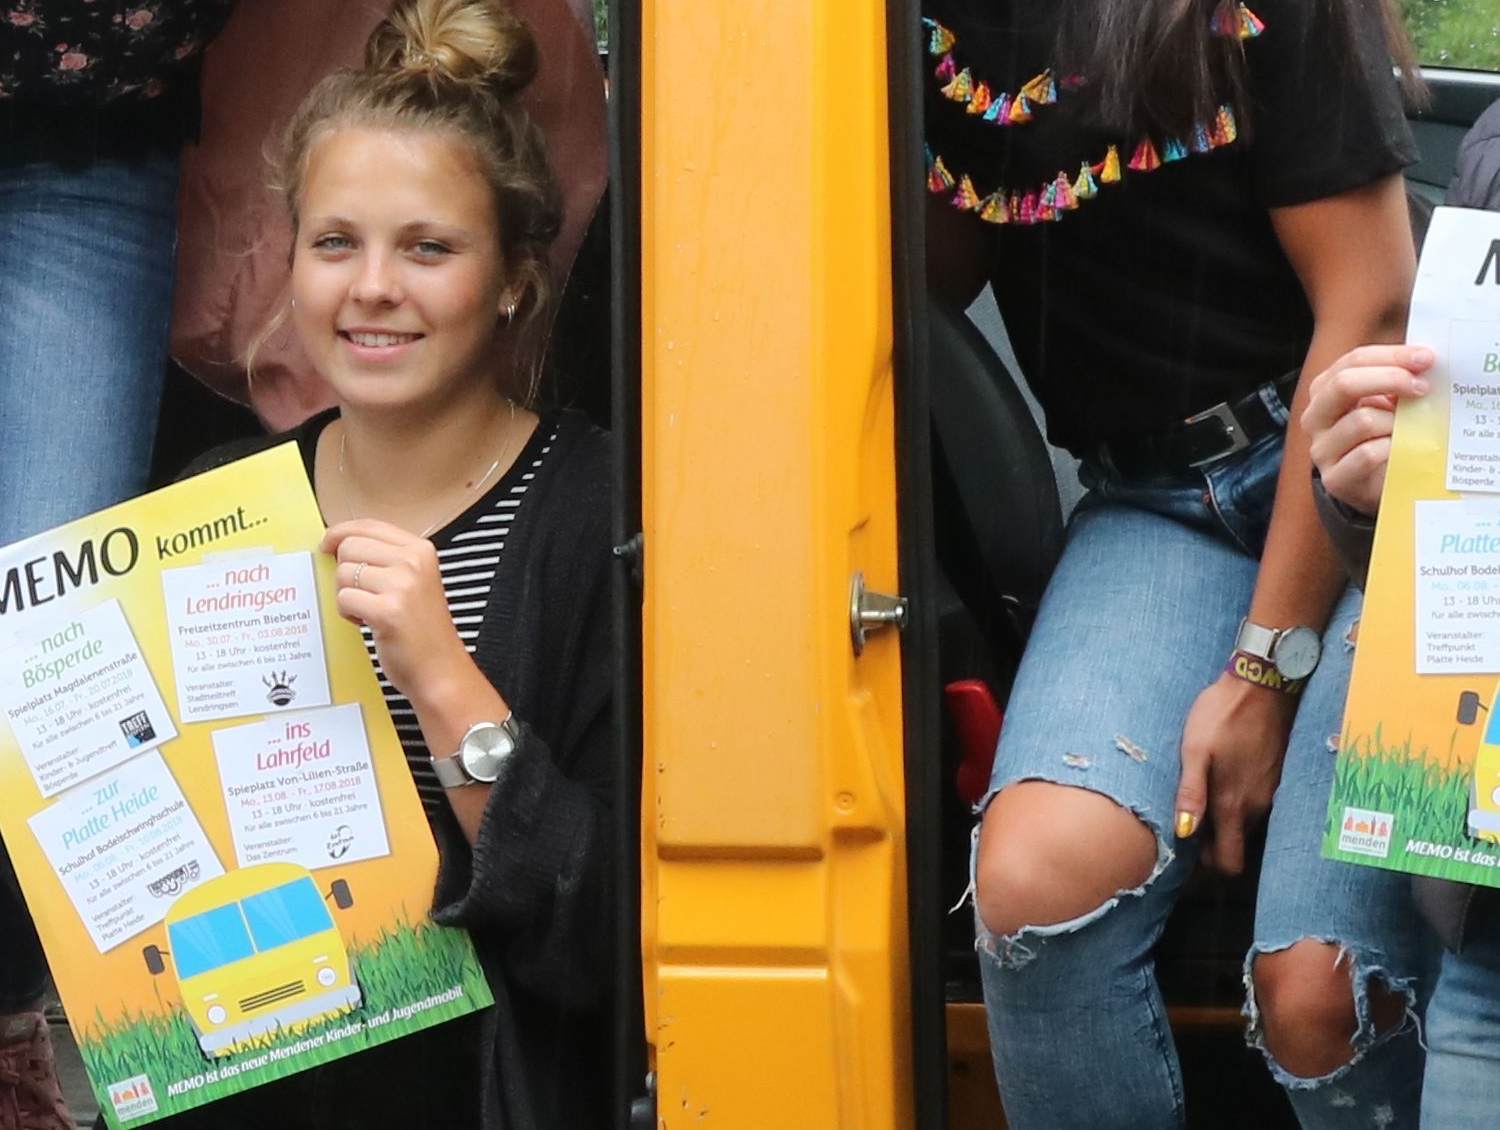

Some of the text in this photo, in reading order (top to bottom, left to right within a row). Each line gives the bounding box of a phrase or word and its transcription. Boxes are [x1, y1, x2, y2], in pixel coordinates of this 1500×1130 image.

[1474, 414, 1486, 424] 13
[1462, 428, 1475, 437] für
[1478, 429, 1493, 438] alle
[155, 505, 269, 560] kommt...
[224, 563, 269, 585] nach
[1420, 565, 1468, 576] Schulhof
[185, 585, 297, 616] Lendringsen
[1443, 596, 1455, 605] 13
[1467, 595, 1479, 605] 18
[177, 609, 311, 635] Freizeitzentrum Biebertal
[39, 620, 85, 654] nach
[1426, 642, 1475, 652] Treffpunkt
[20, 637, 105, 690] Bösperde
[7, 651, 138, 719] Spielplatz Magdalenenstraße
[284, 720, 311, 740] ins
[255, 738, 331, 772] Lahrfeld
[227, 760, 368, 796] Spieplatz Von-Lilien-Straße
[92, 779, 120, 806] zur
[60, 784, 160, 850] Platte Heide
[58, 799, 185, 876] Schulhof Bodelschwinghschule
[1341, 831, 1386, 849] menden
[1405, 838, 1452, 858] MEMO
[1453, 846, 1470, 862] ist
[1470, 850, 1494, 866] das
[165, 986, 465, 1097] MEMO ist das neue Mendener Kinder- und Jugendmobil
[116, 1095, 154, 1116] menden
